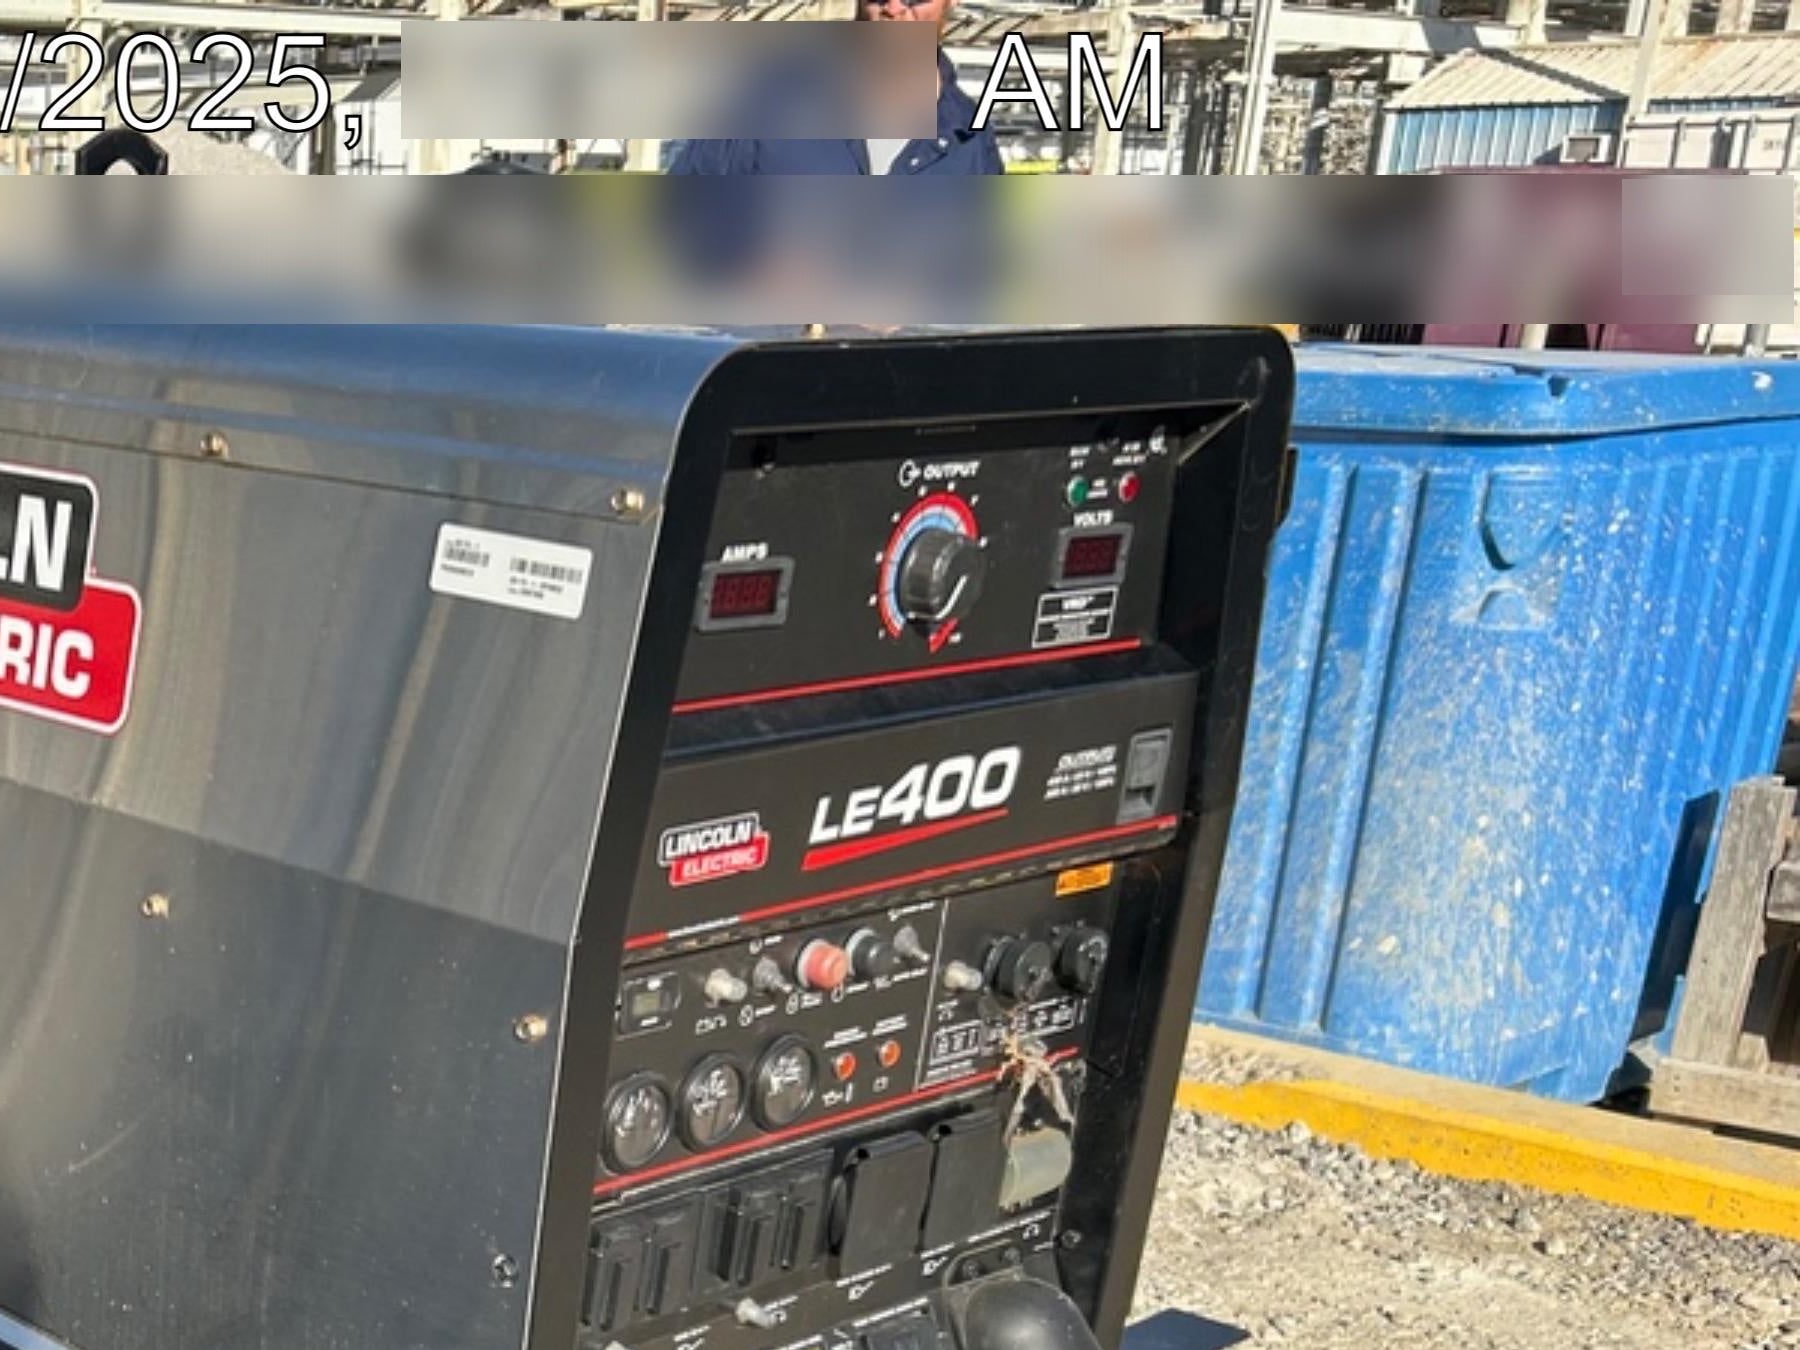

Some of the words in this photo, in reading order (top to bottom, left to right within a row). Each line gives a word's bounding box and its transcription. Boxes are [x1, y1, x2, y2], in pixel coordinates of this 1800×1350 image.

[924, 461, 980, 480] OUTPUT
[721, 542, 769, 562] AMPS
[808, 744, 1022, 845] LE400
[665, 820, 753, 859] LINCOLN
[683, 844, 759, 878] ELECTRIC
